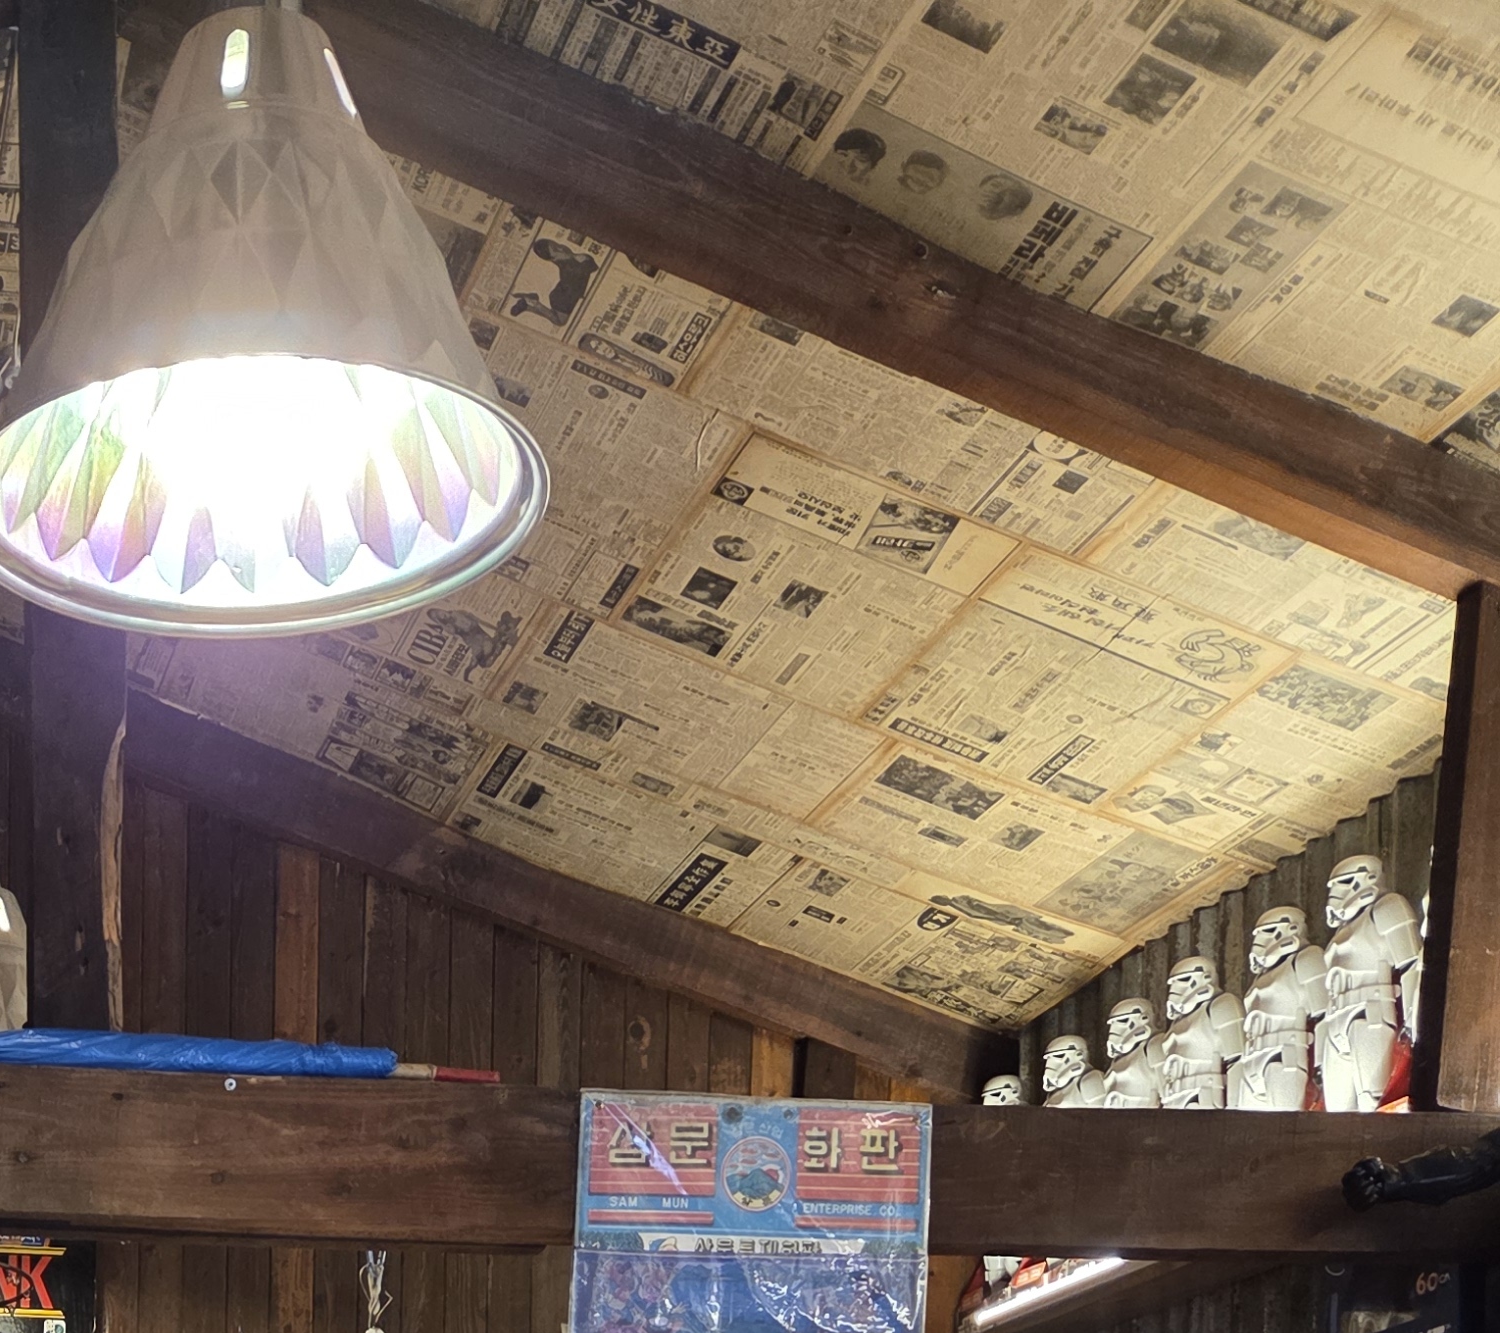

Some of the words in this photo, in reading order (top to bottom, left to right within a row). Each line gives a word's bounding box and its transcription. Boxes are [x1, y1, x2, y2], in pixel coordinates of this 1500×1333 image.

[609, 1196, 638, 1208] SAM
[662, 1197, 689, 1209] MUN
[803, 1203, 872, 1216] ENTERPRISE
